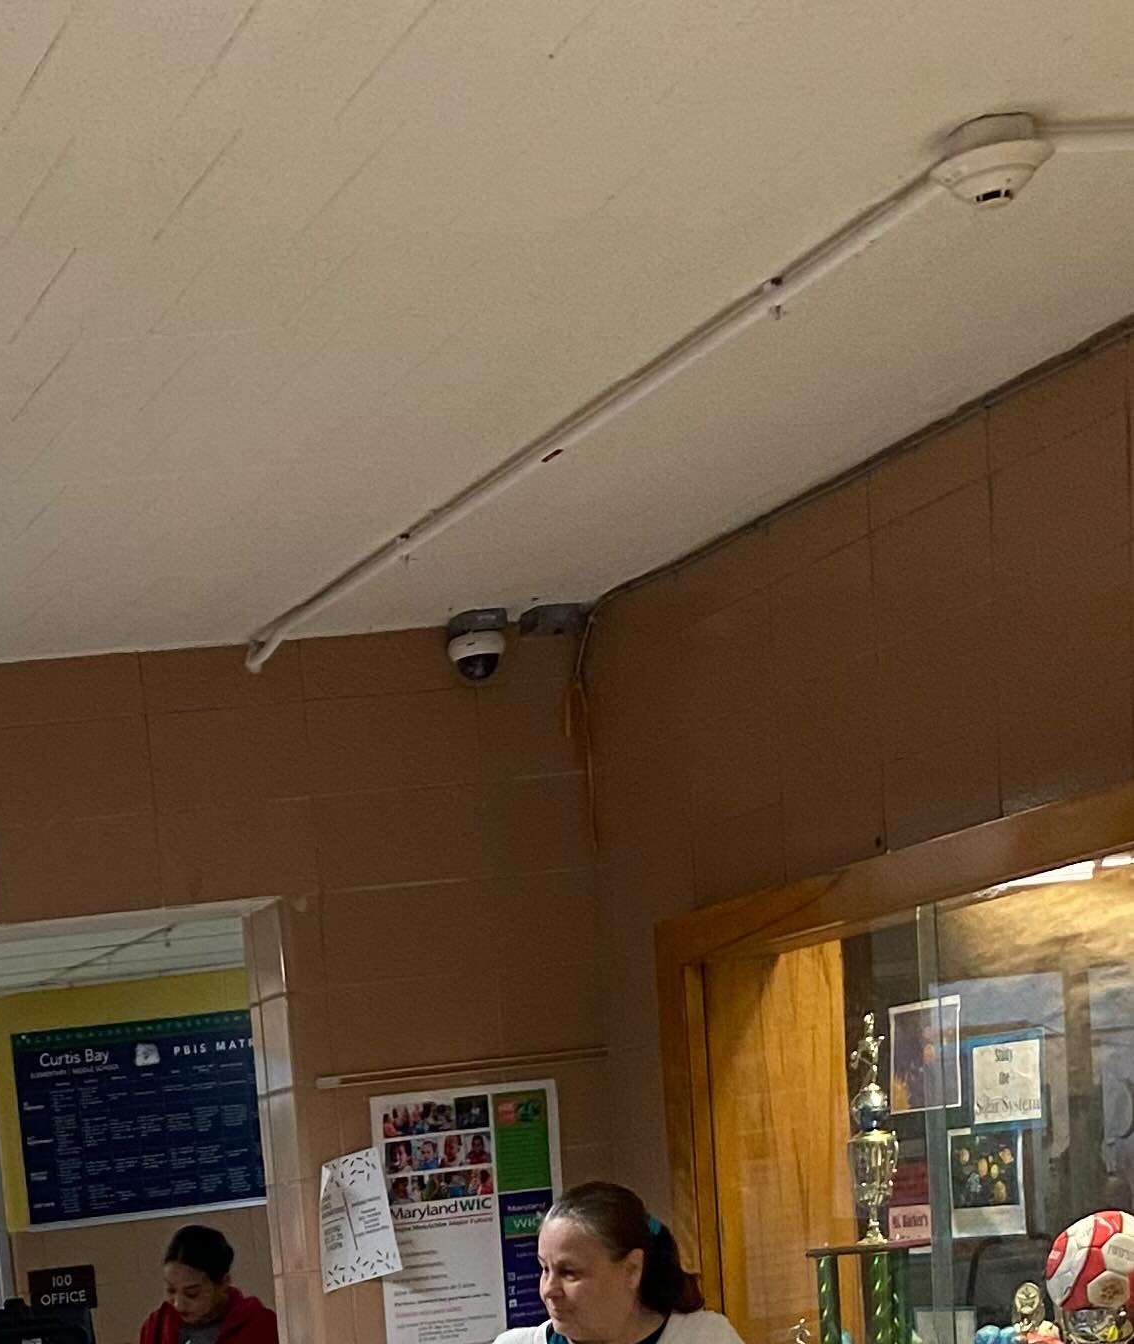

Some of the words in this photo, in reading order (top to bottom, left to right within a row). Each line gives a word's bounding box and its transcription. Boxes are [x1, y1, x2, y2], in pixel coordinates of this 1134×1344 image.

[173, 1042, 208, 1056] PBIS
[39, 1050, 82, 1068] Curtis
[84, 1048, 110, 1066] Bay
[52, 1274, 73, 1289] 100
[40, 1289, 87, 1306] OFFICE
